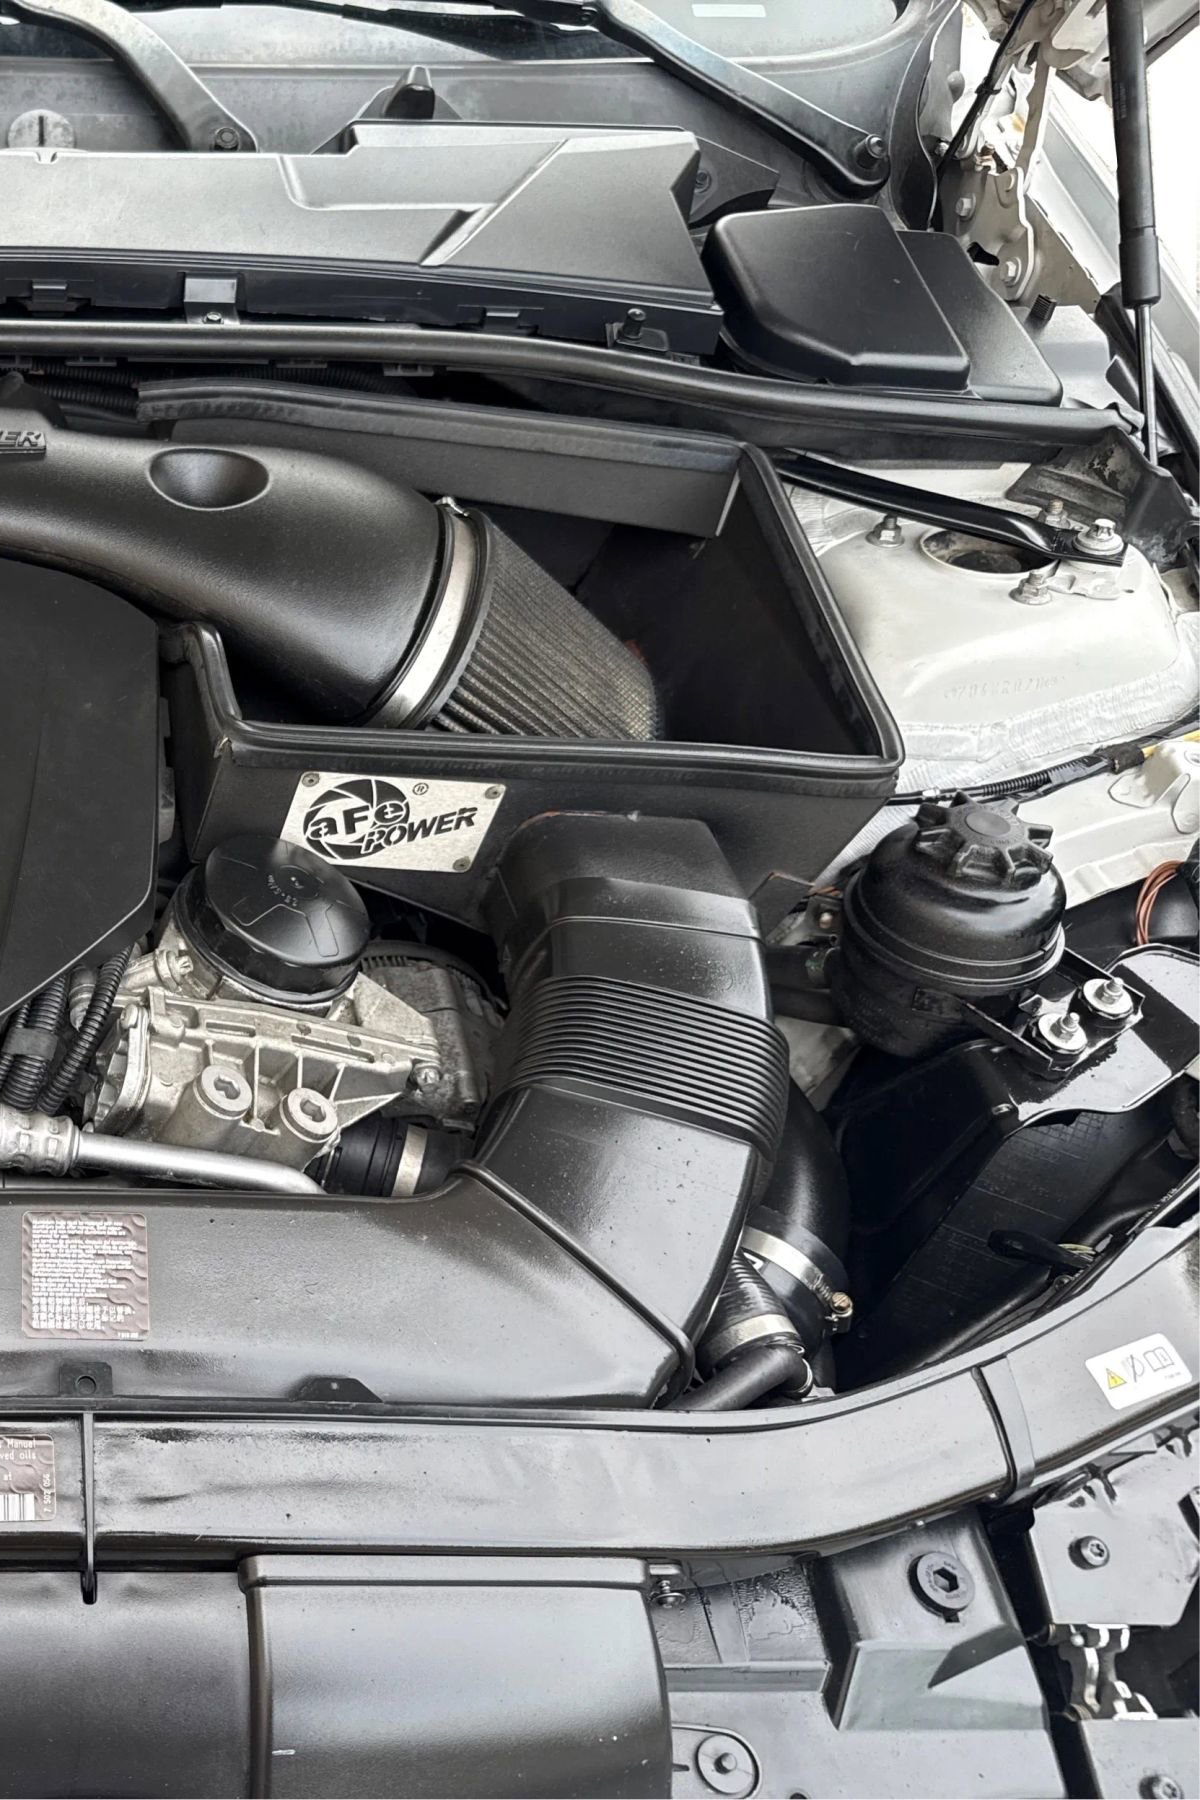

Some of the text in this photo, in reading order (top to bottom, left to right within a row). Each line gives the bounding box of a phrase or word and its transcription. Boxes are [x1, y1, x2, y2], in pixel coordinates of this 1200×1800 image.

[309, 801, 405, 839] aFe
[361, 806, 479, 855] POWER
[20, 1450, 36, 1460] oils
[3, 1472, 13, 1481] at
